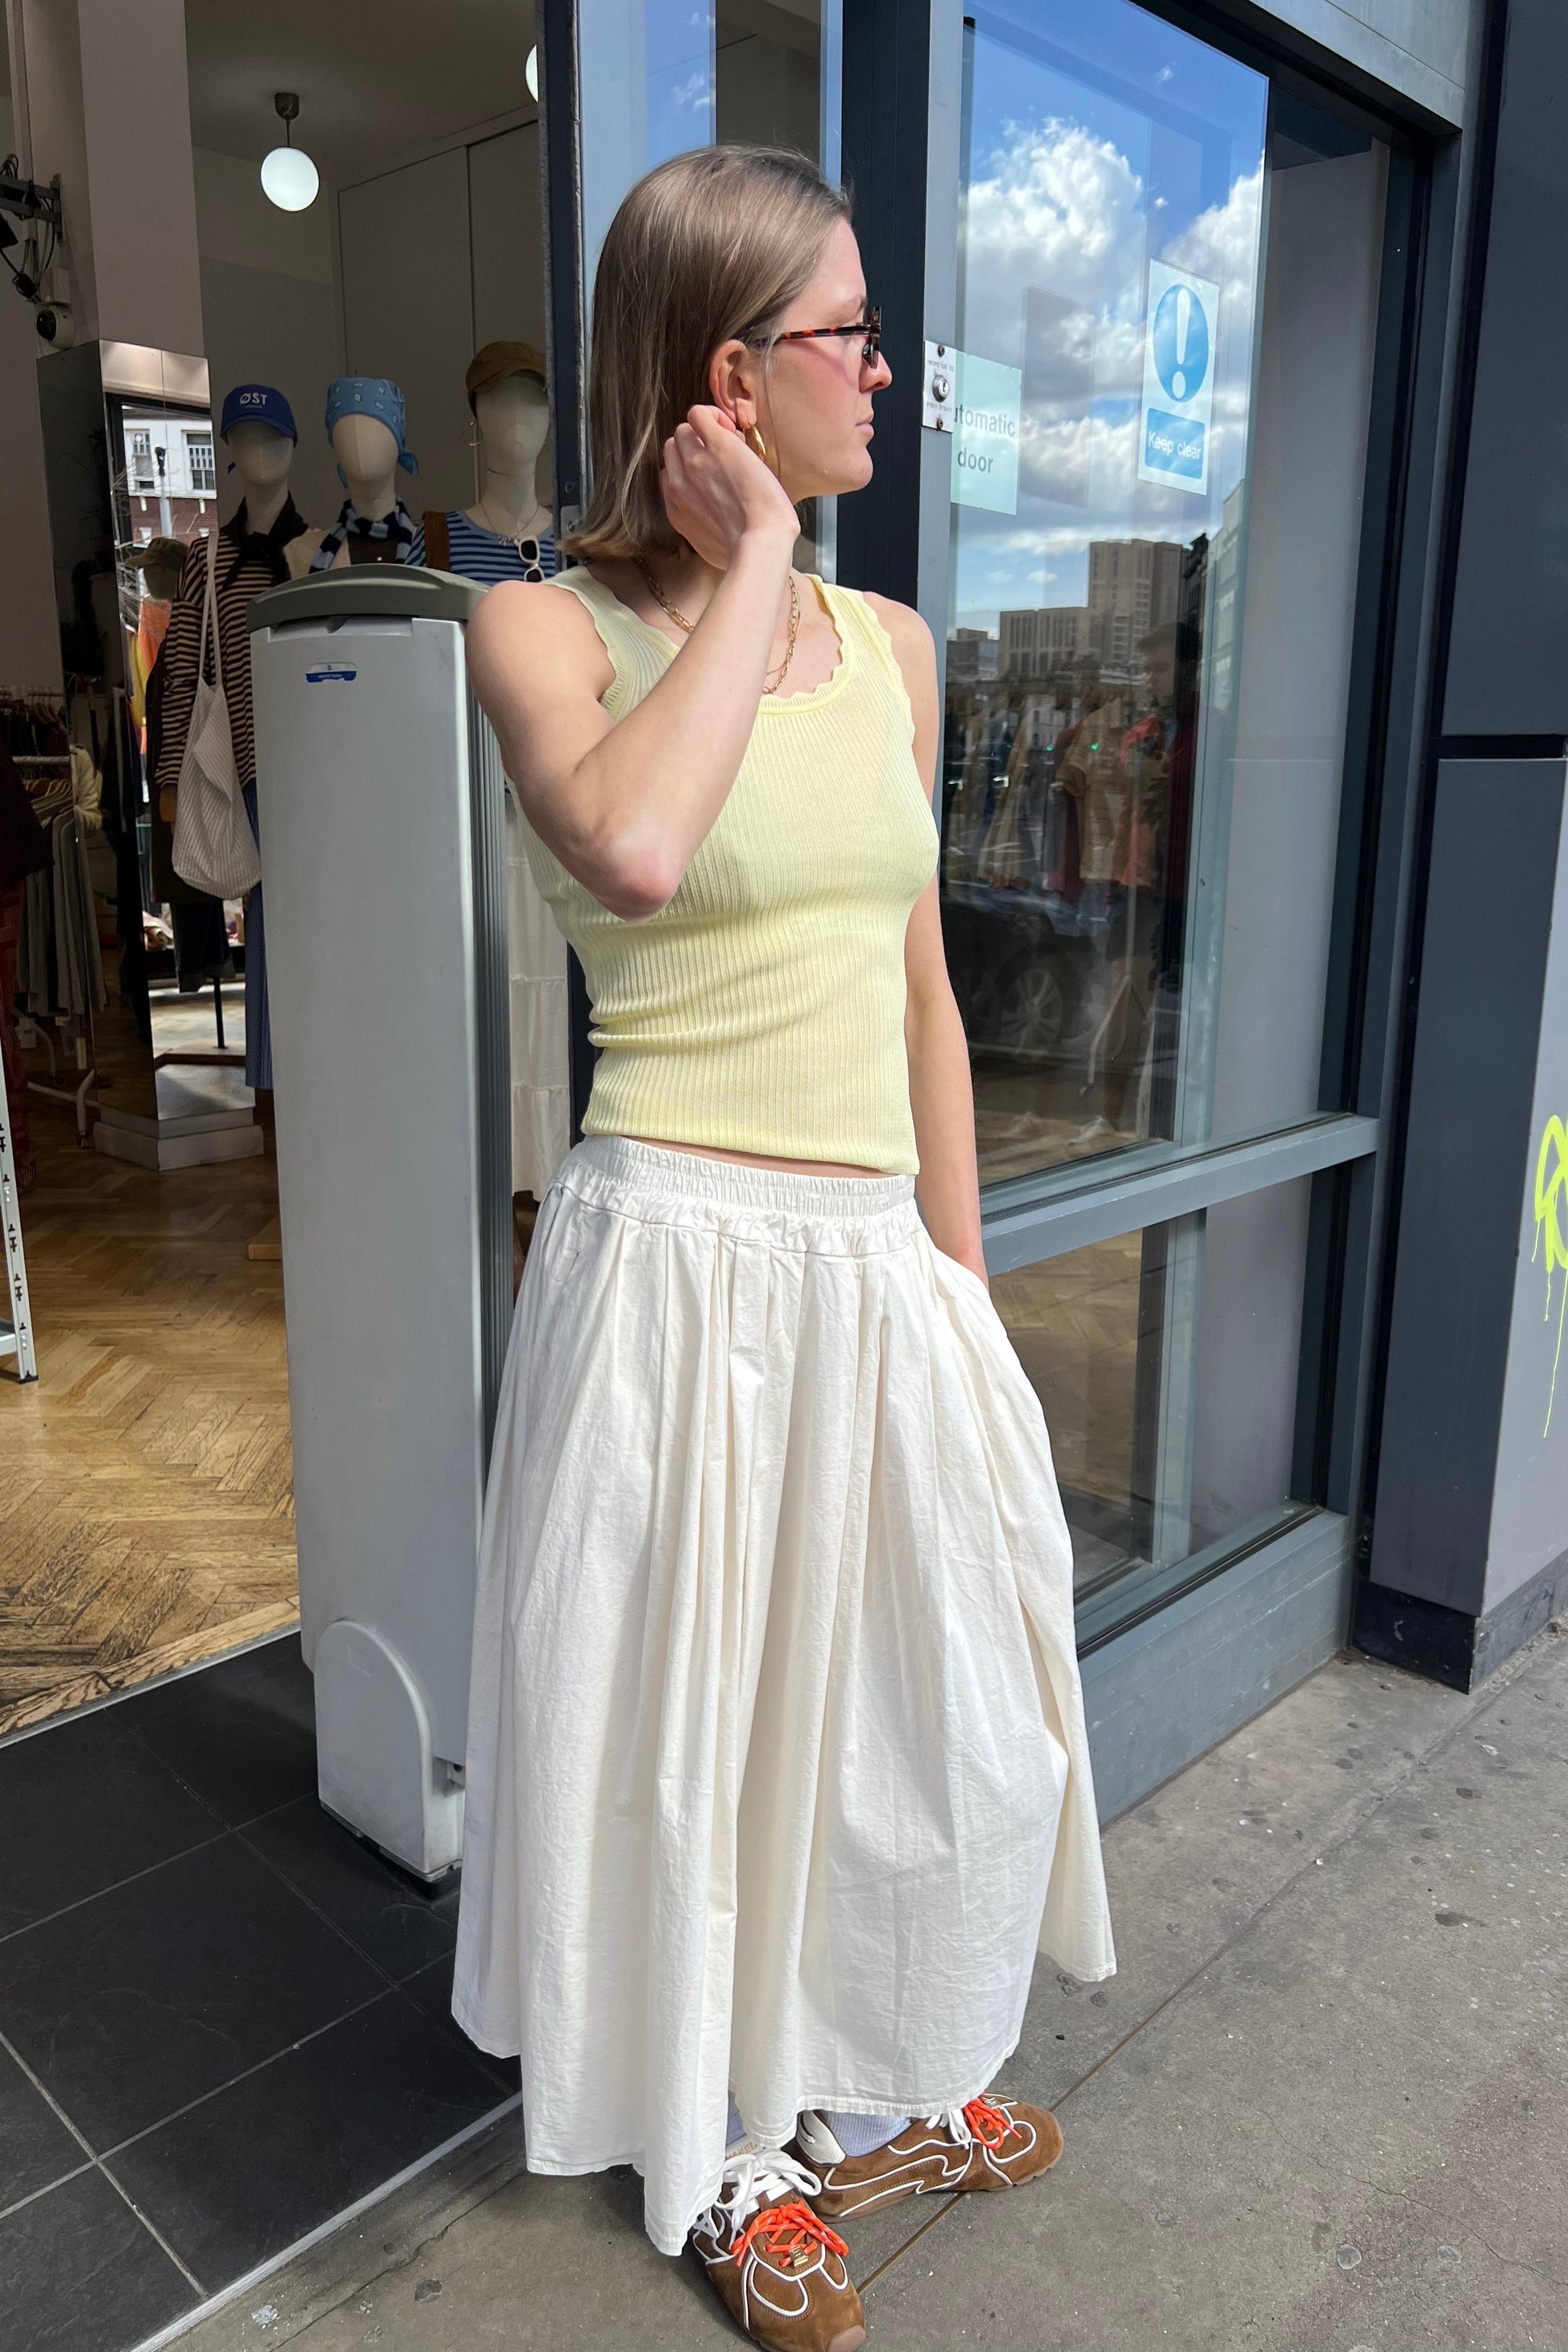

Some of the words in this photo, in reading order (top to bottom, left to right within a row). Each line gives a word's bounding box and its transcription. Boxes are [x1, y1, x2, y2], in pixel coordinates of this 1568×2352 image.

[240, 392, 268, 405] ØST
[954, 404, 1015, 438] tomatic
[1148, 430, 1174, 457] Keep
[1177, 441, 1201, 460] clear
[957, 446, 993, 474] door
